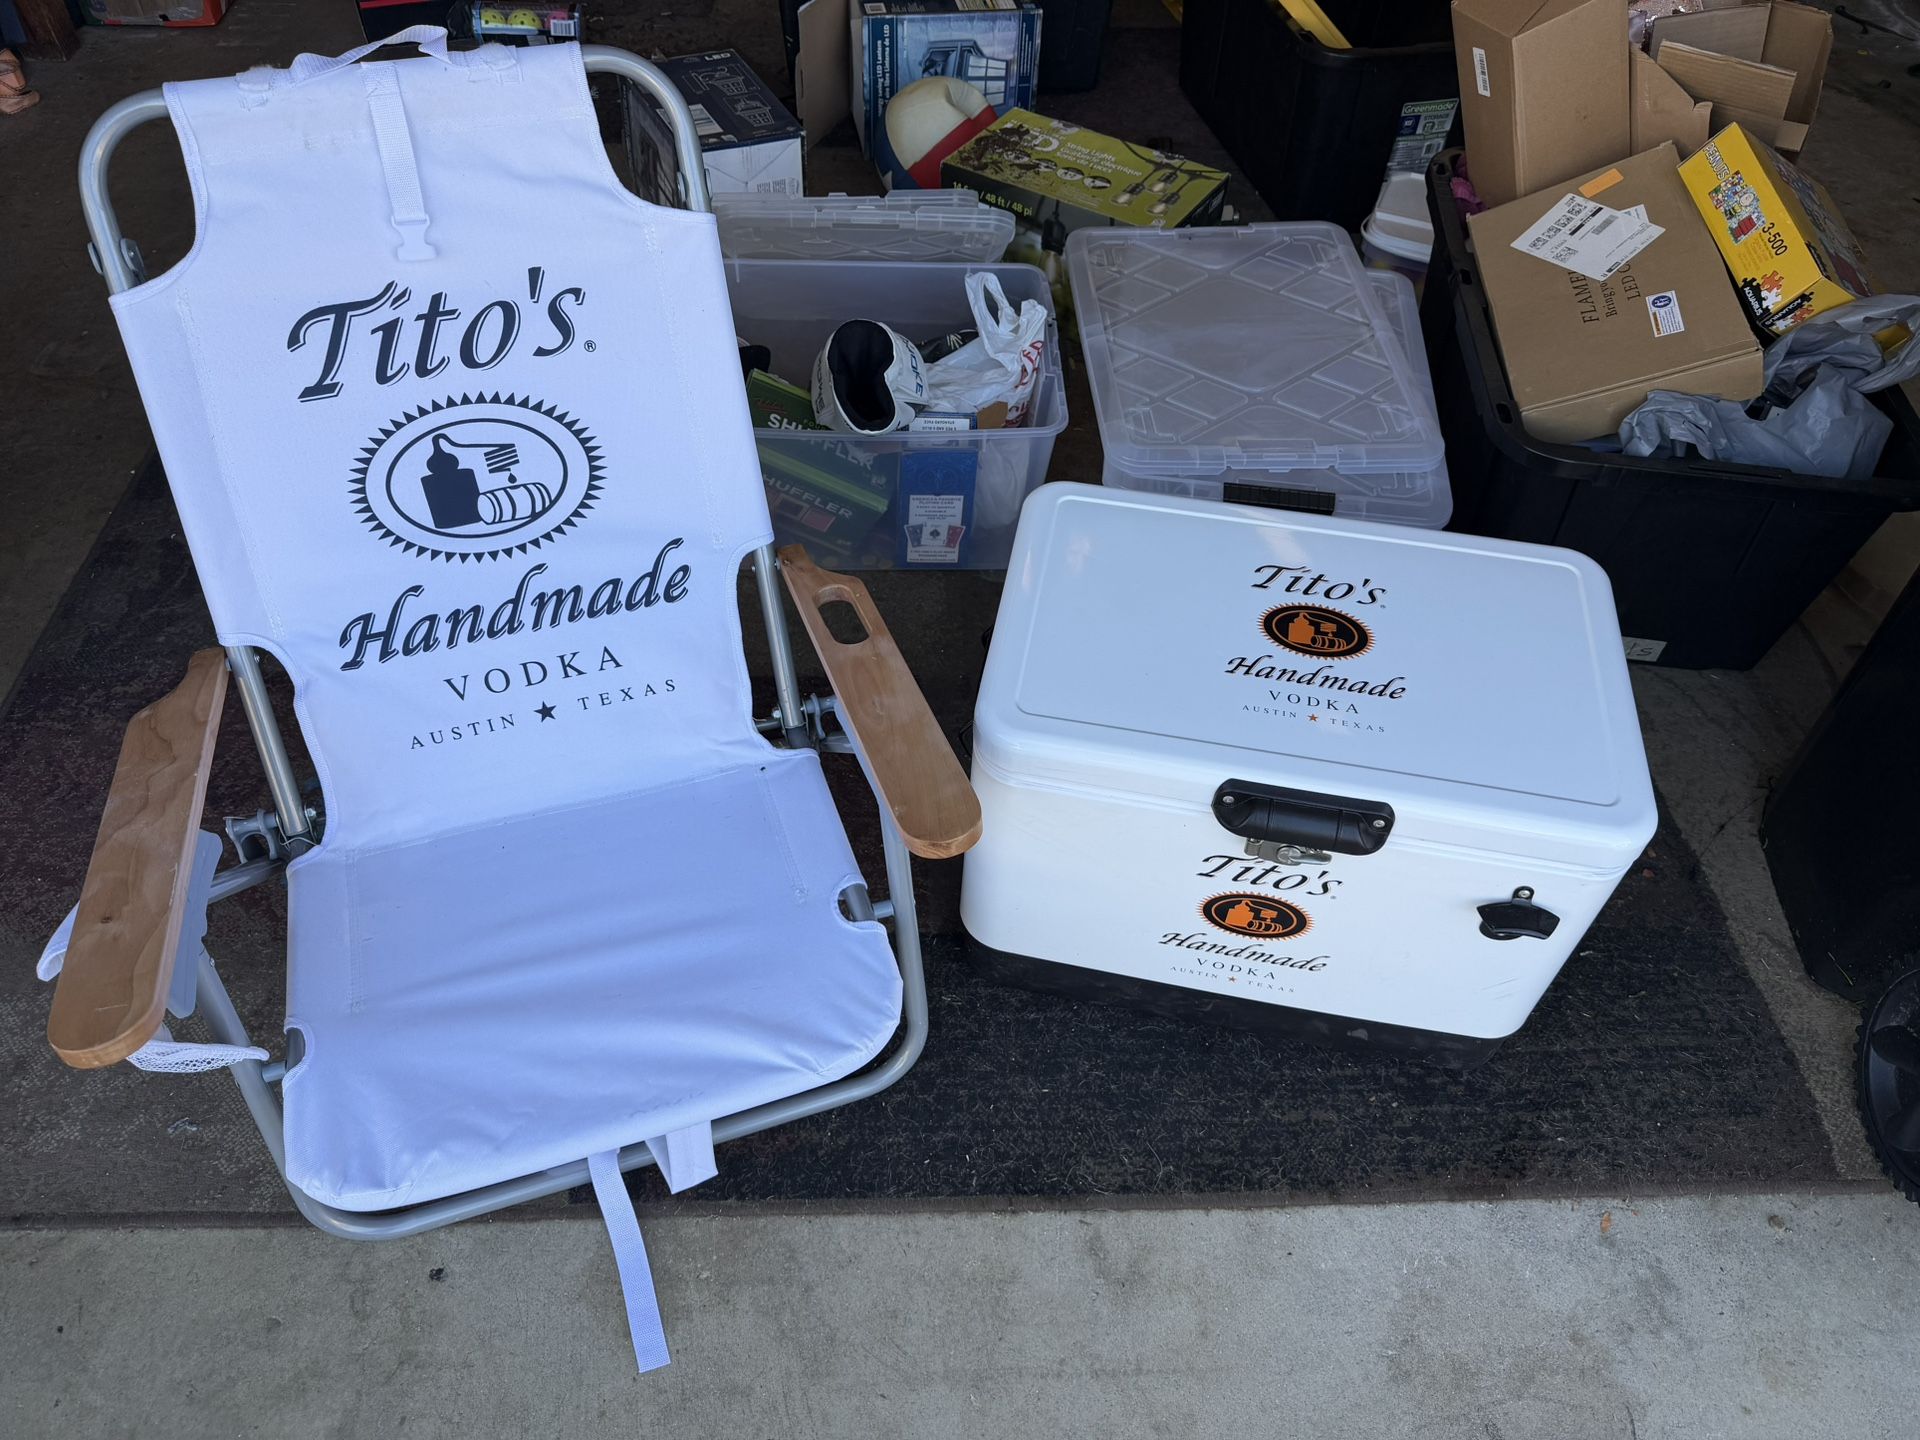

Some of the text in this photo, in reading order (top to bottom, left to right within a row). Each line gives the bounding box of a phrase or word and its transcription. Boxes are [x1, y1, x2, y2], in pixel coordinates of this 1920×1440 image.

[704, 53, 731, 61] LED
[1404, 101, 1454, 114] Greenmade
[1703, 141, 1730, 181] PEANUTS
[985, 193, 996, 202] 48
[997, 197, 1005, 207] ft
[1011, 202, 1023, 212] 48
[1023, 207, 1033, 216] pi
[1761, 222, 1788, 256] 3-500
[1621, 275, 1641, 300] LED
[1743, 286, 1763, 316] AQUARIUS
[1765, 298, 1802, 325] AQUARIUS
[287, 266, 586, 402] Tito's
[763, 474, 853, 518] HUFFLER
[1251, 564, 1387, 606] Tito's
[339, 537, 691, 671] Handmade
[443, 645, 623, 701] VODKA
[1224, 655, 1407, 700] Handmade
[410, 678, 677, 750] AUSTIN TEXAS
[1242, 704, 1386, 733] AUSTIN TEXAS
[1268, 690, 1359, 714] VODKA
[1196, 854, 1343, 896] Tito's
[1158, 932, 1330, 973] Handmade
[1196, 958, 1276, 980] VODKA
[1170, 966, 1295, 993] AUSTIN TEXAS
